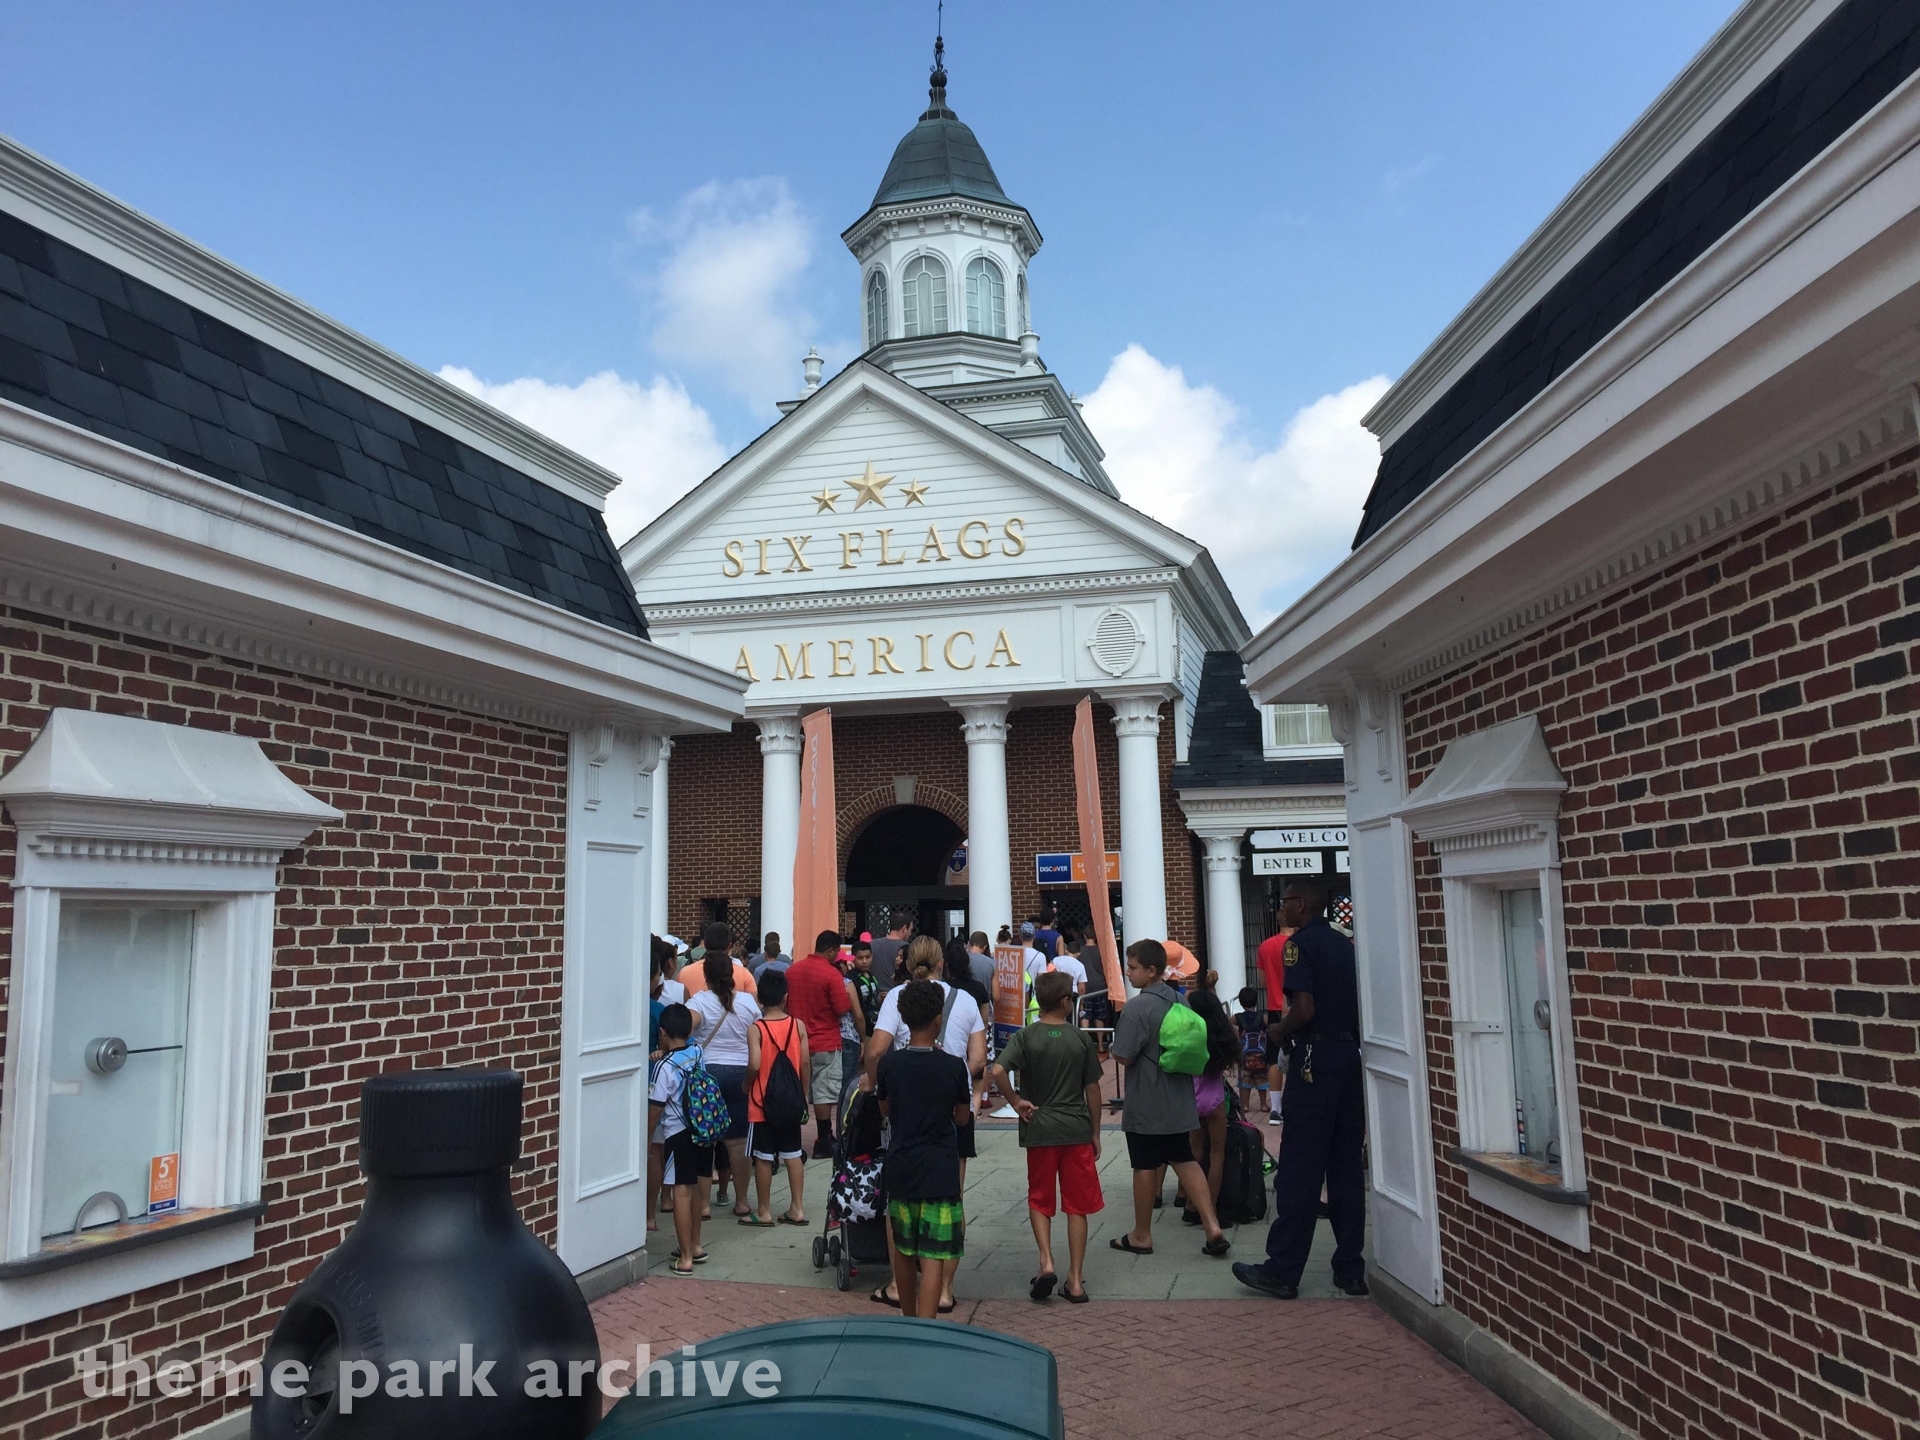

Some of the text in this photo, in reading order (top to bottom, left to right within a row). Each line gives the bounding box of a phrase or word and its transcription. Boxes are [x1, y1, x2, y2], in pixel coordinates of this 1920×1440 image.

[722, 517, 1026, 578] SIX FLAGS
[734, 627, 1021, 682] AMERICA
[1281, 831, 1346, 843] WELCO
[1263, 858, 1313, 869] ENTER
[998, 950, 1020, 973] FAST
[998, 973, 1020, 989] ENTRY
